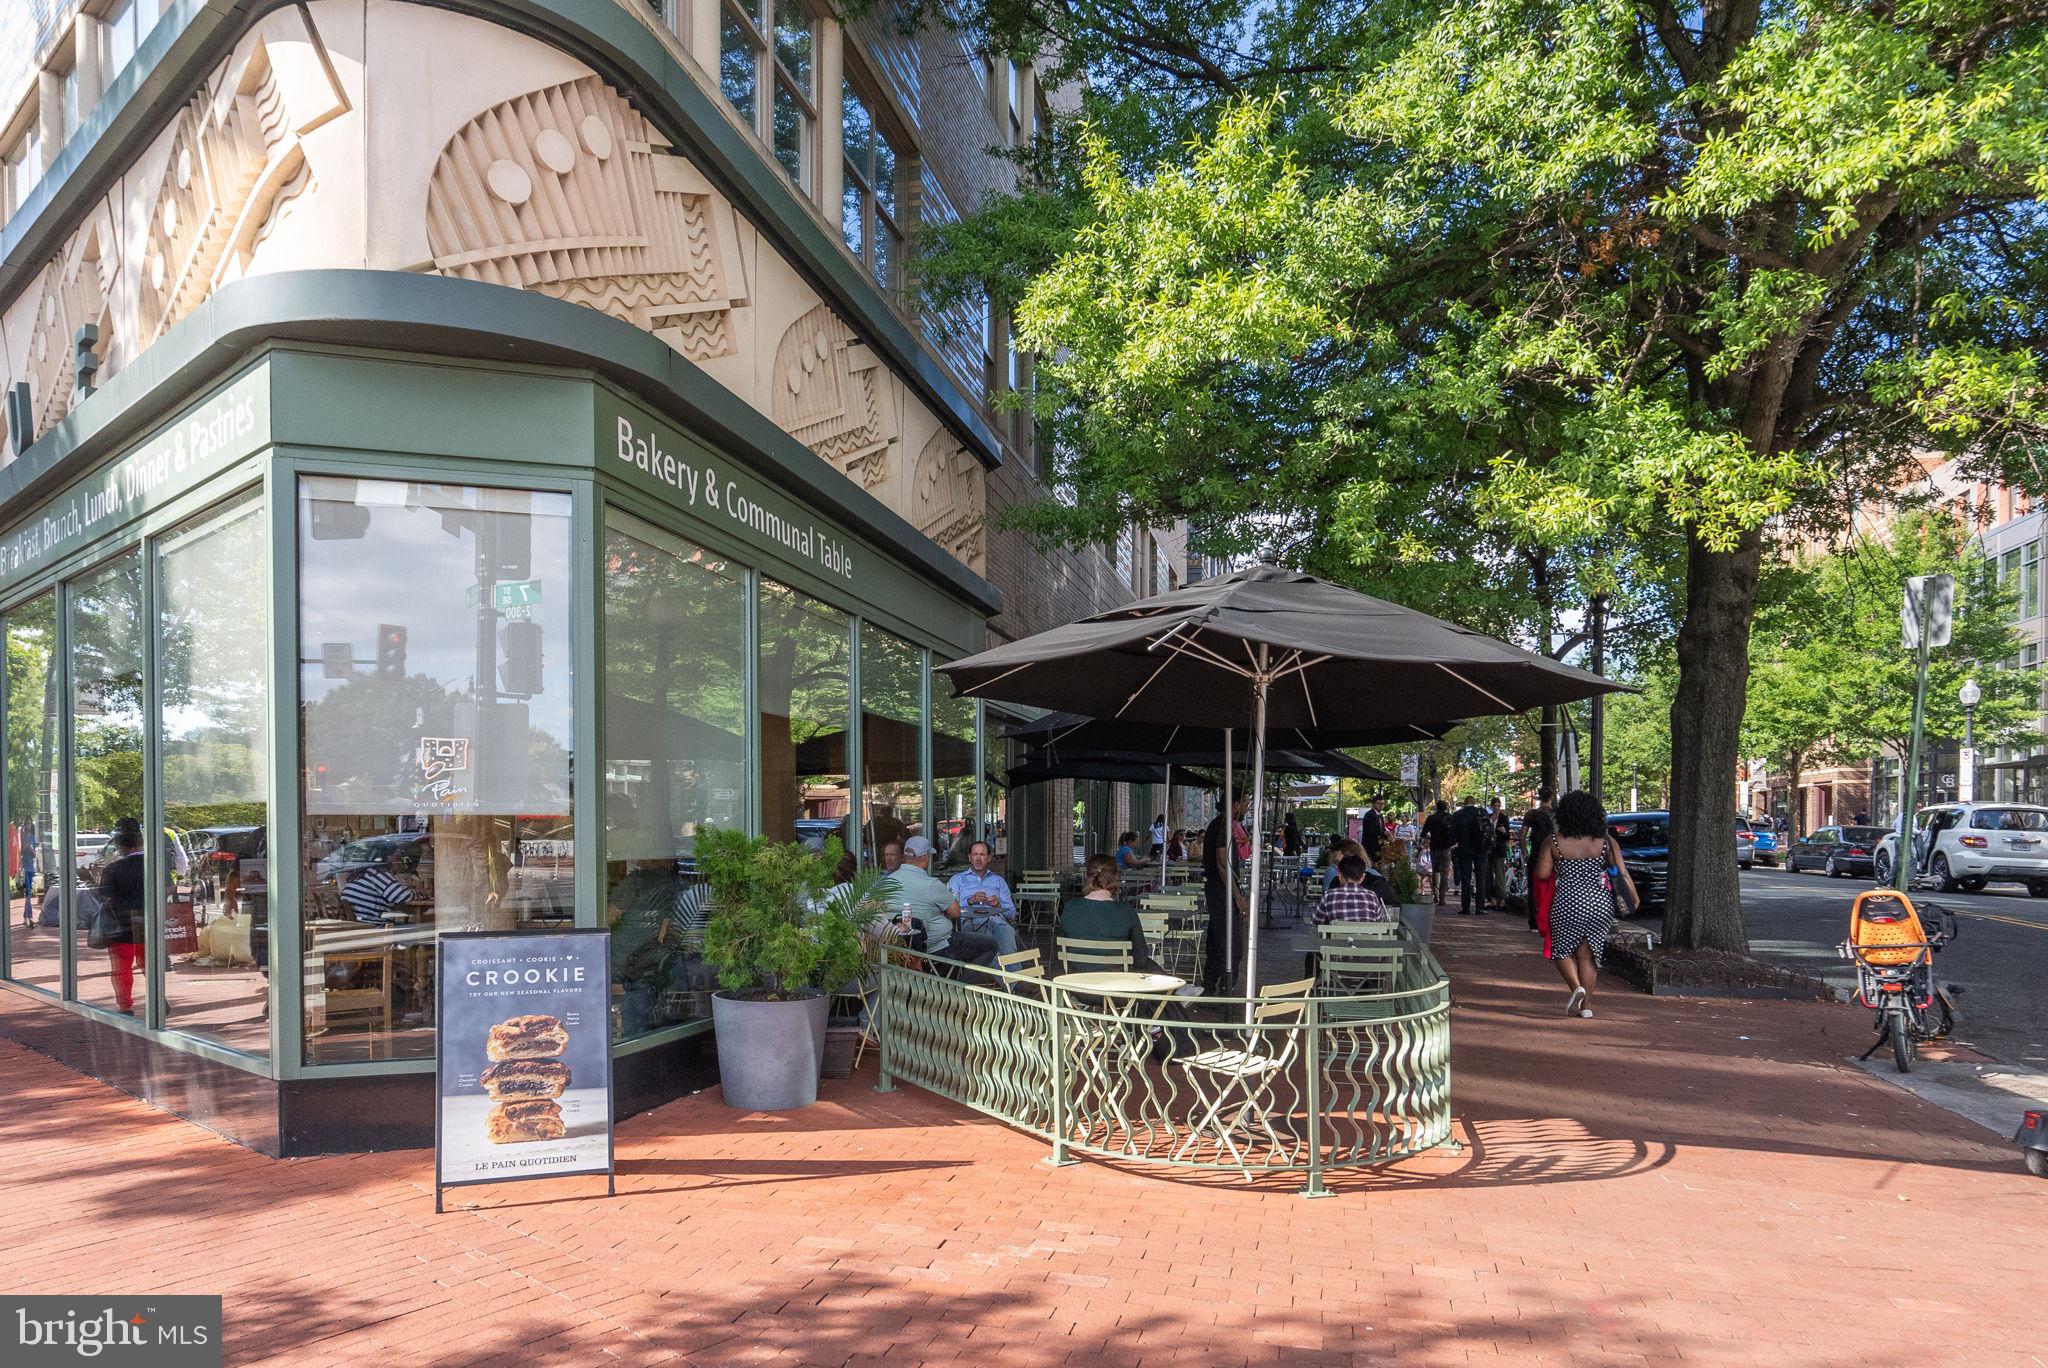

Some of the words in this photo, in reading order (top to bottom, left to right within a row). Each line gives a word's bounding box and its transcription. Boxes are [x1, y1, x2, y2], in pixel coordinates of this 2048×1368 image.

[43, 499, 82, 551] Brunch,
[84, 474, 122, 526] Lunch,
[126, 449, 171, 502] Dinner
[174, 430, 186, 473] &
[190, 393, 254, 465] Pastries
[617, 416, 698, 506] Bakery
[705, 468, 720, 510] &
[726, 481, 814, 559] Communal
[817, 532, 852, 579] Table
[422, 776, 467, 800] Pain
[471, 957, 517, 965] CROISSANT
[466, 966, 585, 986] CROOKIE
[475, 1163, 489, 1171] LE
[491, 1161, 516, 1169] PAIN
[519, 1155, 577, 1167] QUOTIDIEN
